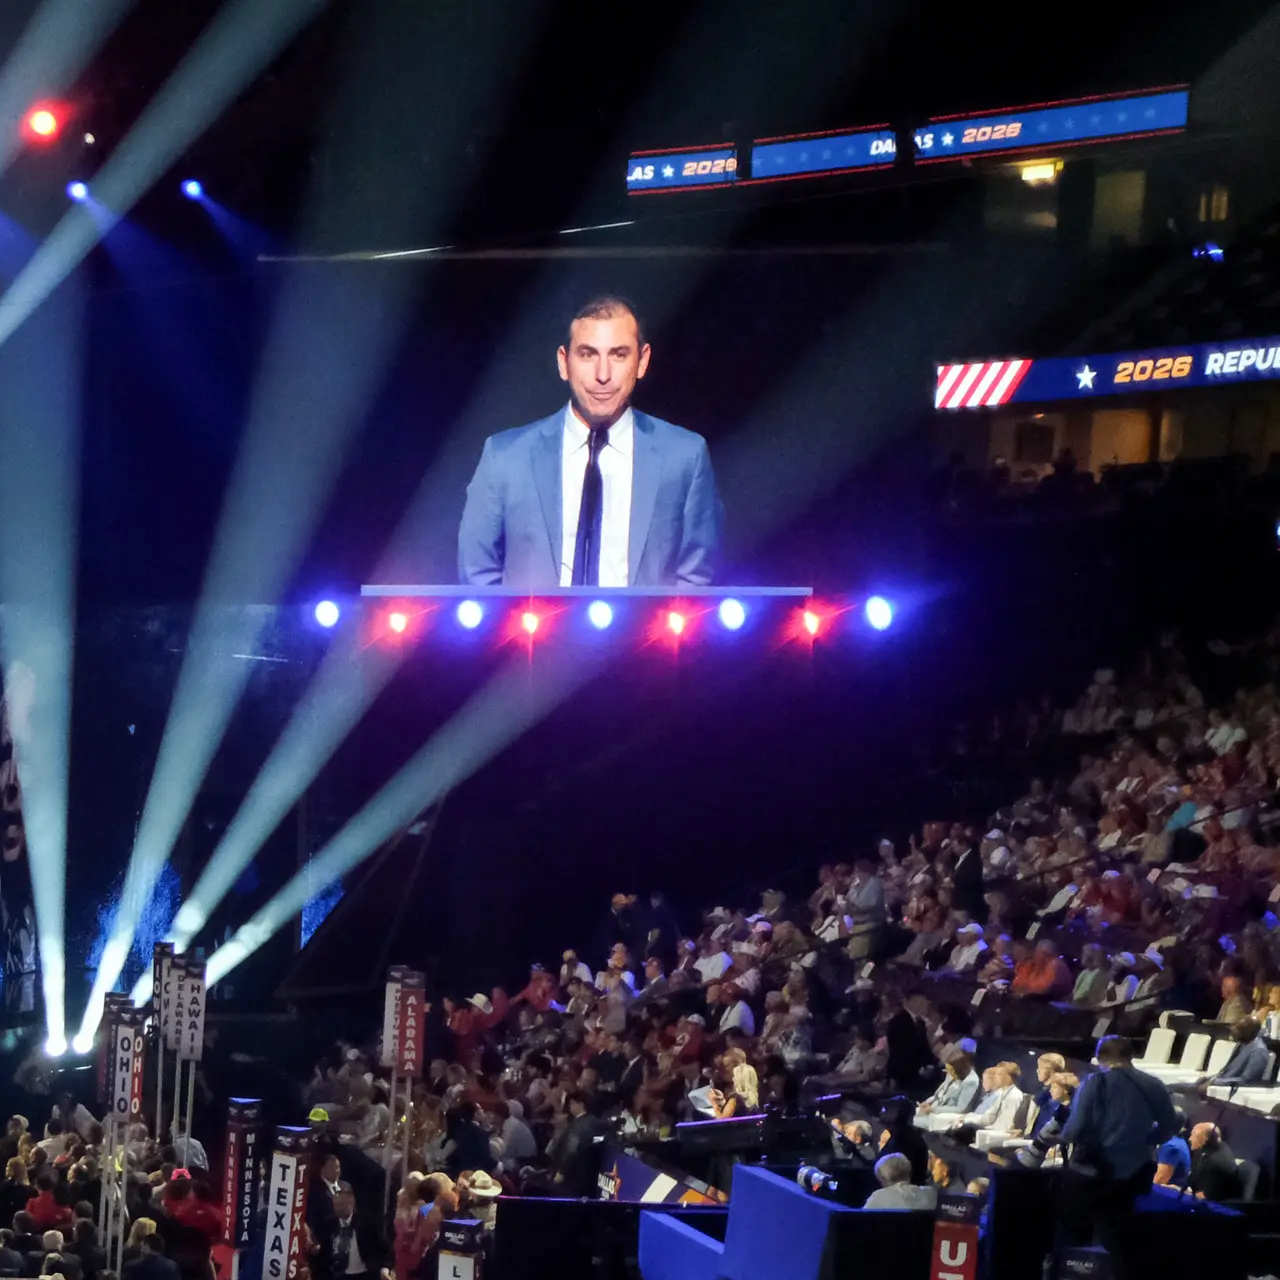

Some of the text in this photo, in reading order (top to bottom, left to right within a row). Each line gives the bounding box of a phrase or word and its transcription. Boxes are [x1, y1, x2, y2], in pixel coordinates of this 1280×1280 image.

[681, 157, 738, 176] 2026
[961, 122, 1022, 144] 2026
[1114, 355, 1193, 384] 2026
[187, 984, 201, 1054] HAWAII
[404, 995, 417, 1071] ALABAMA
[116, 1036, 131, 1114] OHIO
[131, 1036, 143, 1114] OHIO
[224, 1132, 236, 1240] MINNESOTA
[241, 1132, 255, 1242] MINNESOTA
[269, 1163, 290, 1278] TEXAS
[288, 1163, 307, 1279] TEXAS
